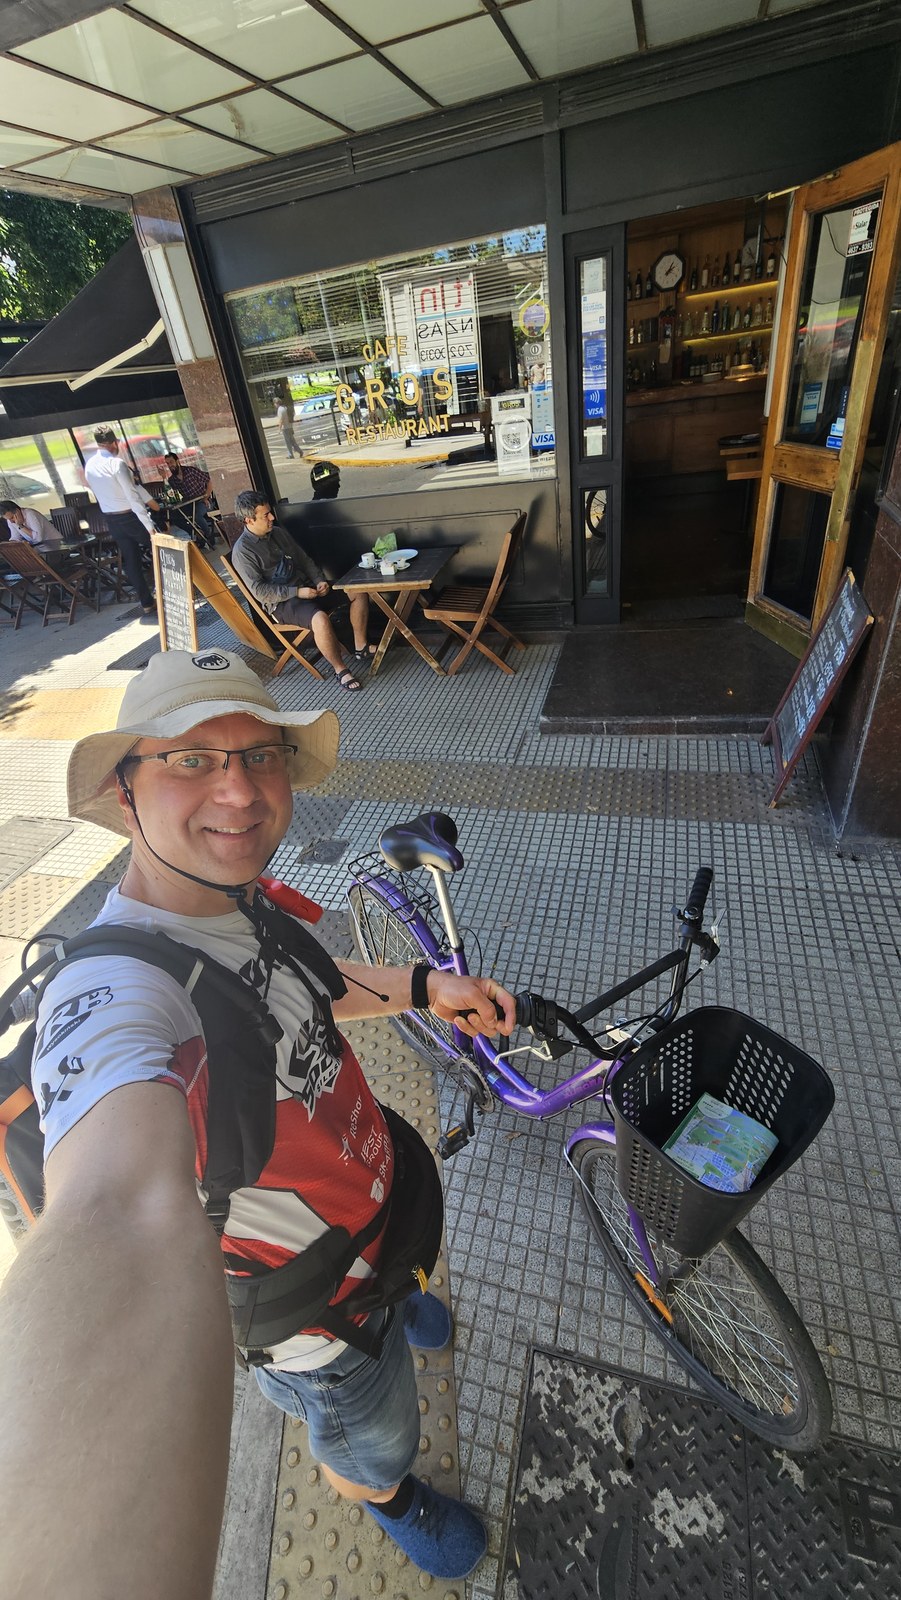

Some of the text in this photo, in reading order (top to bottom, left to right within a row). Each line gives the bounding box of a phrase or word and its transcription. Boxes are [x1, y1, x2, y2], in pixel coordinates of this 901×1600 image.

[362, 336, 407, 362] CAFE
[335, 367, 453, 415] GROS
[587, 407, 603, 415] VISA
[346, 414, 450, 445] RESTAURANT
[535, 434, 554, 443] VISA
